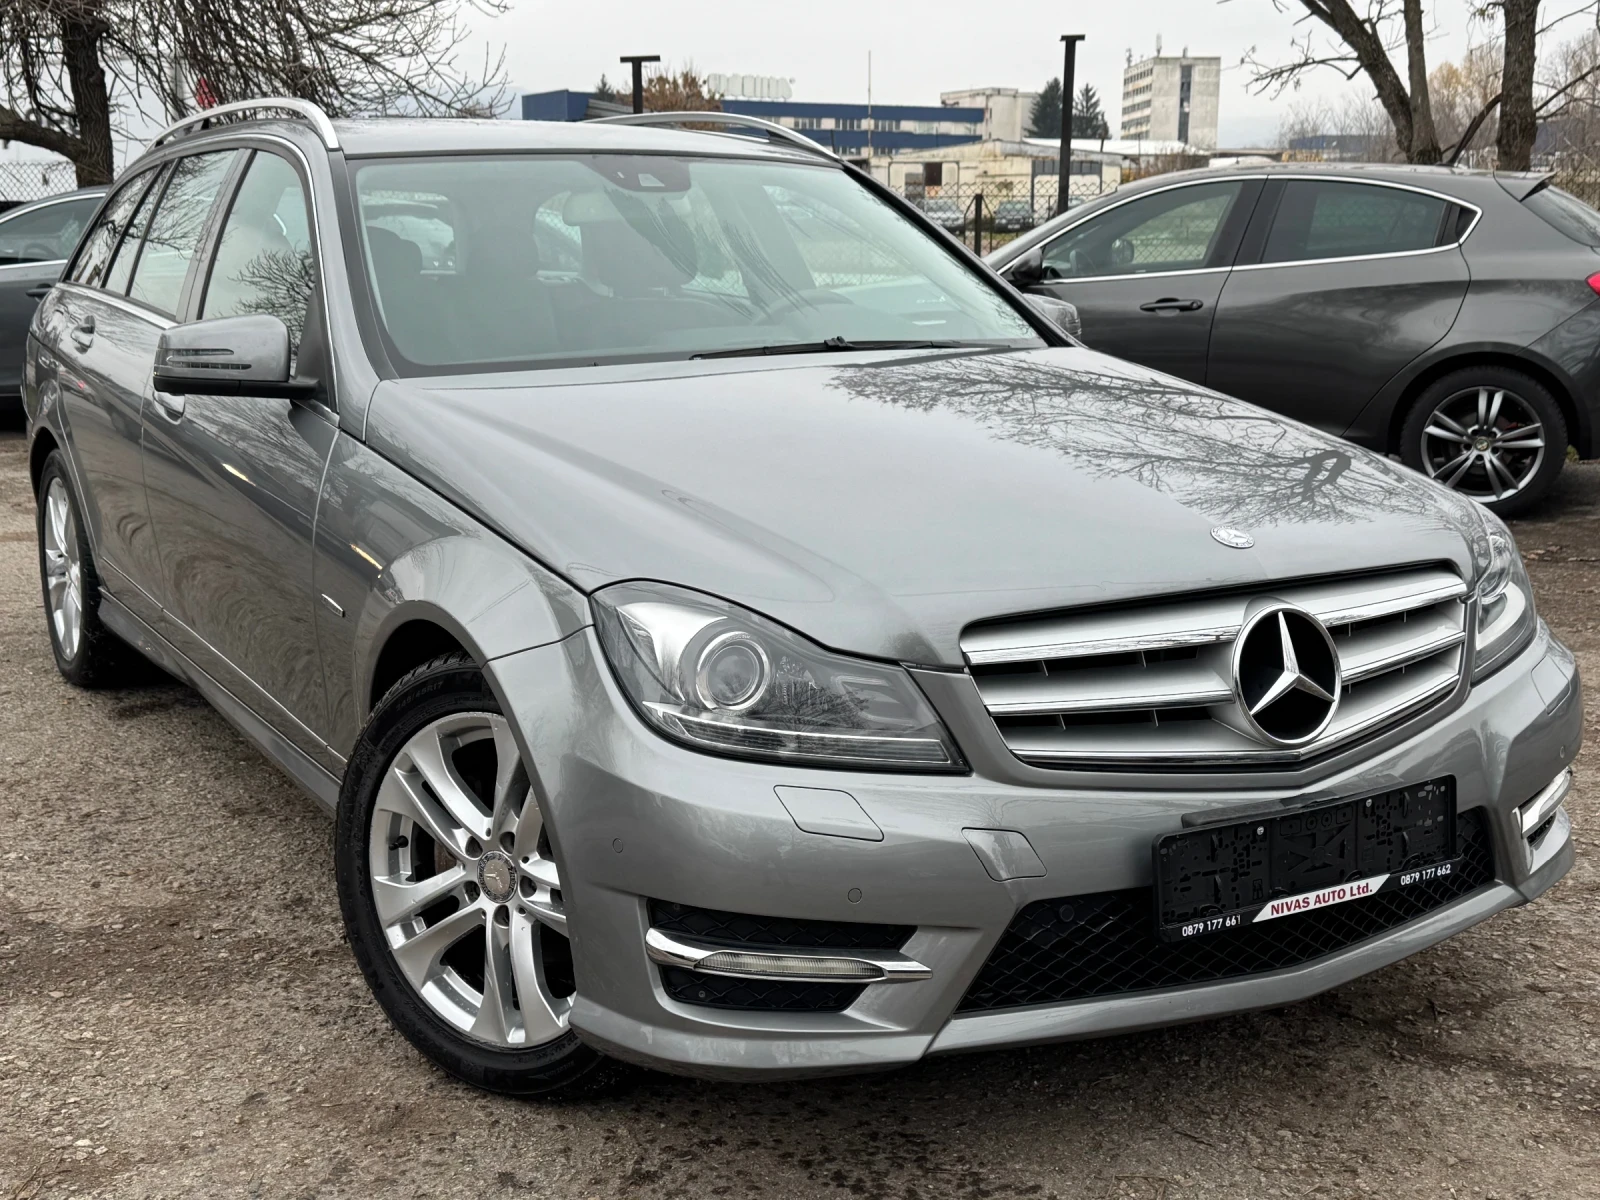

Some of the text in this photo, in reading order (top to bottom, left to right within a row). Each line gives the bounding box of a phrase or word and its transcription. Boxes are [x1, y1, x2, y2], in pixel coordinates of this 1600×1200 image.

[1400, 864, 1451, 886] 0879 177 662
[1270, 882, 1373, 916] NIVAS AUTO Ltd.
[1182, 914, 1241, 937] 0879 177 661
